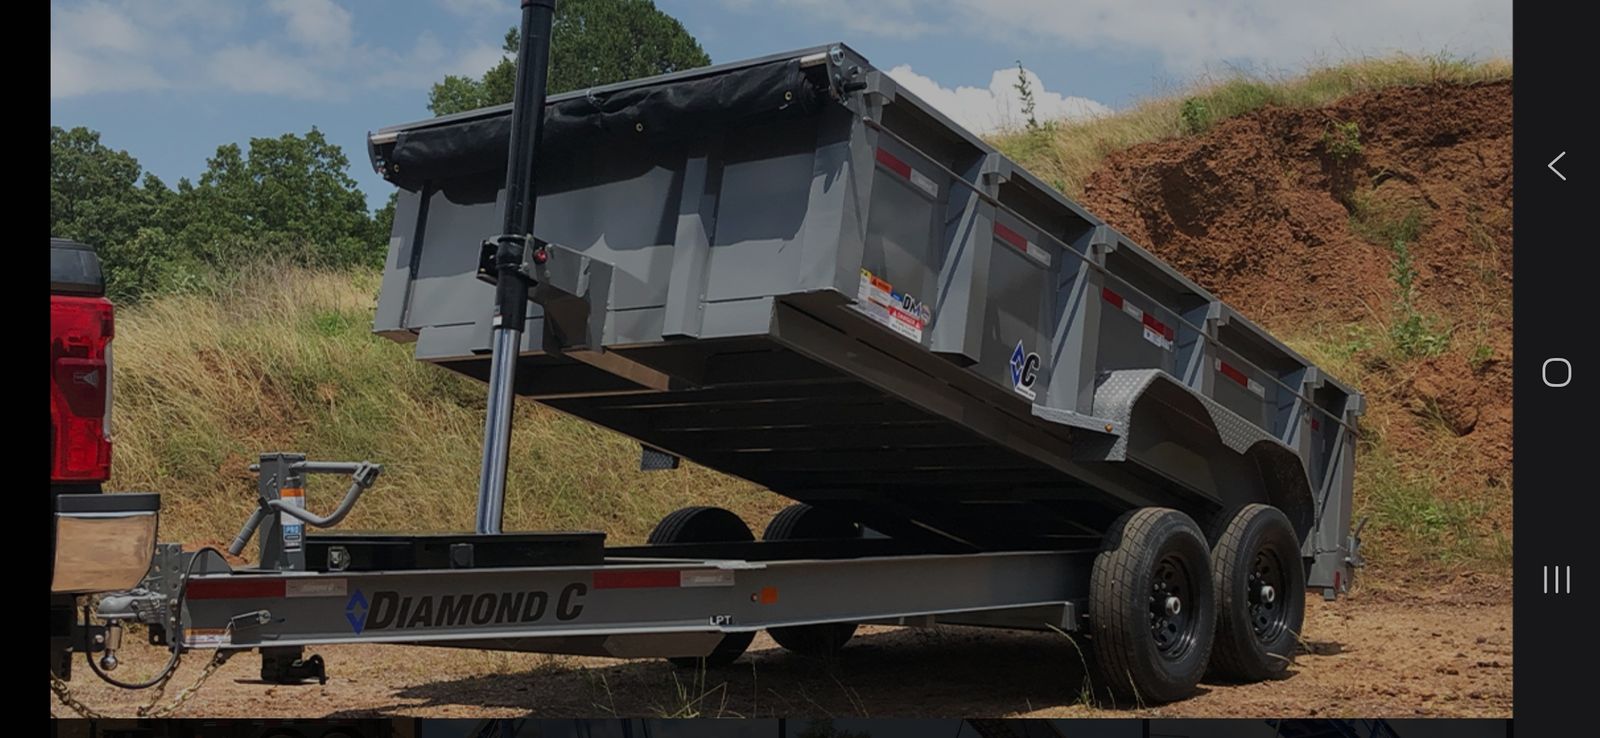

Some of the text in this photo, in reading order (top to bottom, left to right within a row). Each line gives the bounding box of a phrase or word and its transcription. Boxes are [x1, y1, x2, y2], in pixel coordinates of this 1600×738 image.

[1021, 353, 1040, 387] C
[555, 582, 588, 621] C
[709, 615, 732, 626] LPT
